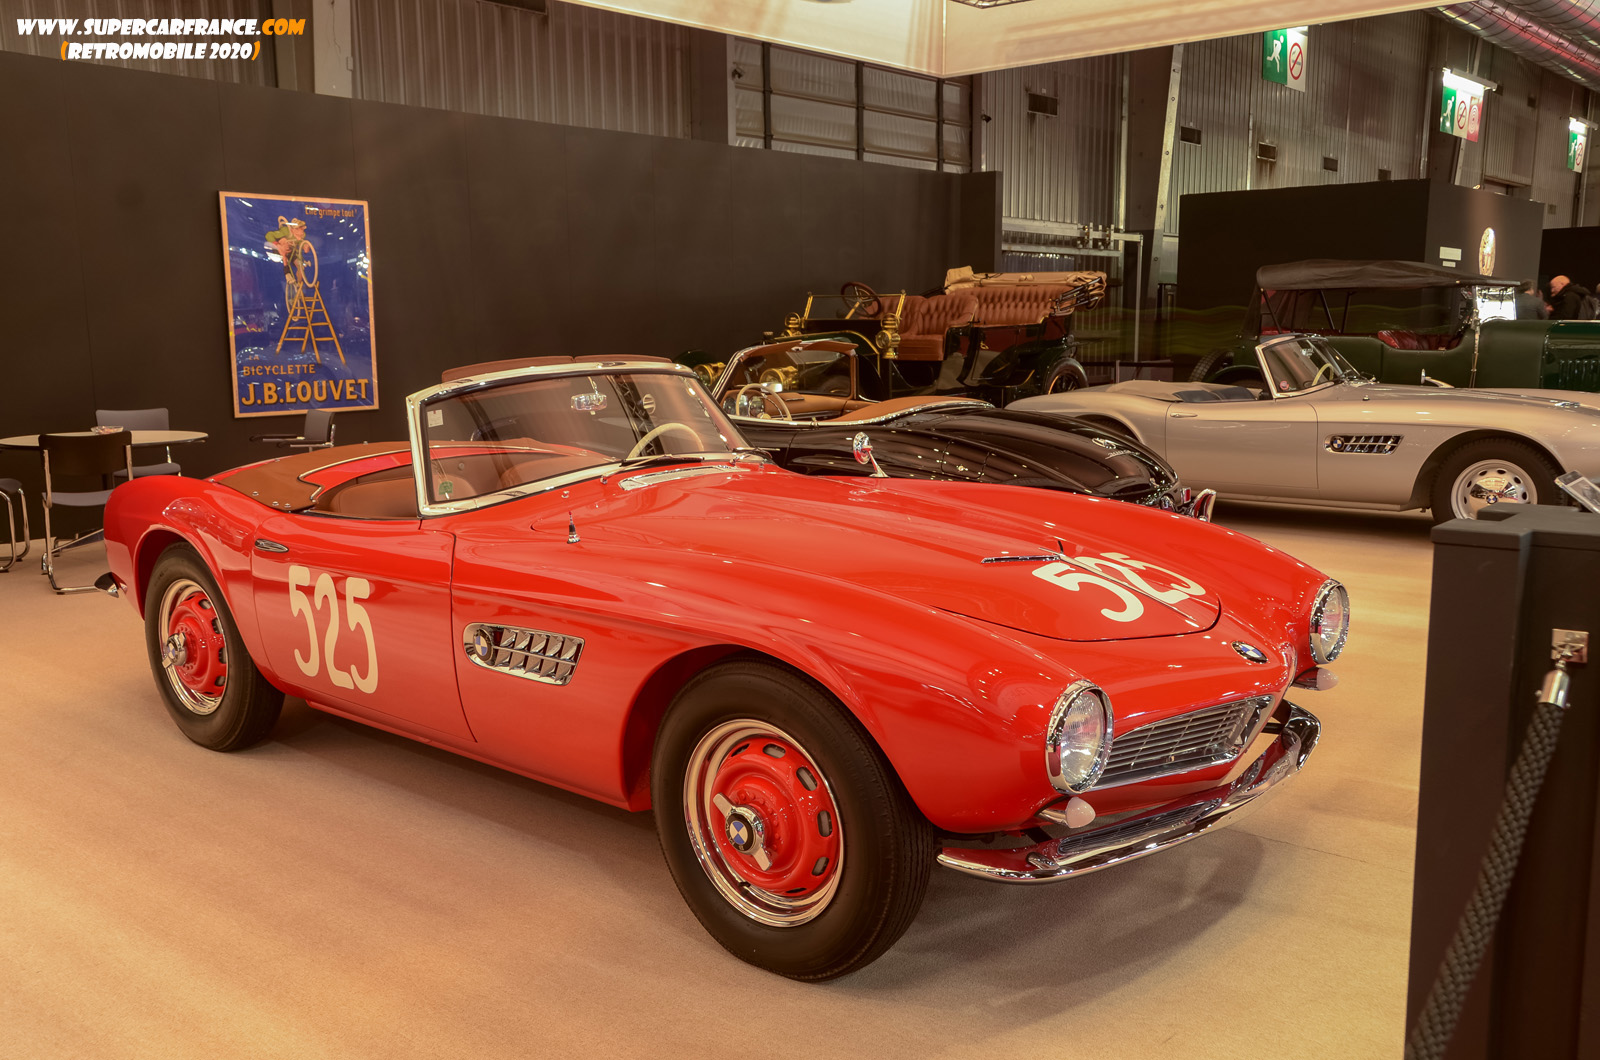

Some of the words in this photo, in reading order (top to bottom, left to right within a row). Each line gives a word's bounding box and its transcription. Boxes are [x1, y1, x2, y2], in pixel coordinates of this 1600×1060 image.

[318, 208, 340, 220] grimpe
[242, 364, 316, 377] BICYCLETTE
[1031, 551, 1206, 623] 525
[288, 564, 379, 694] 525
